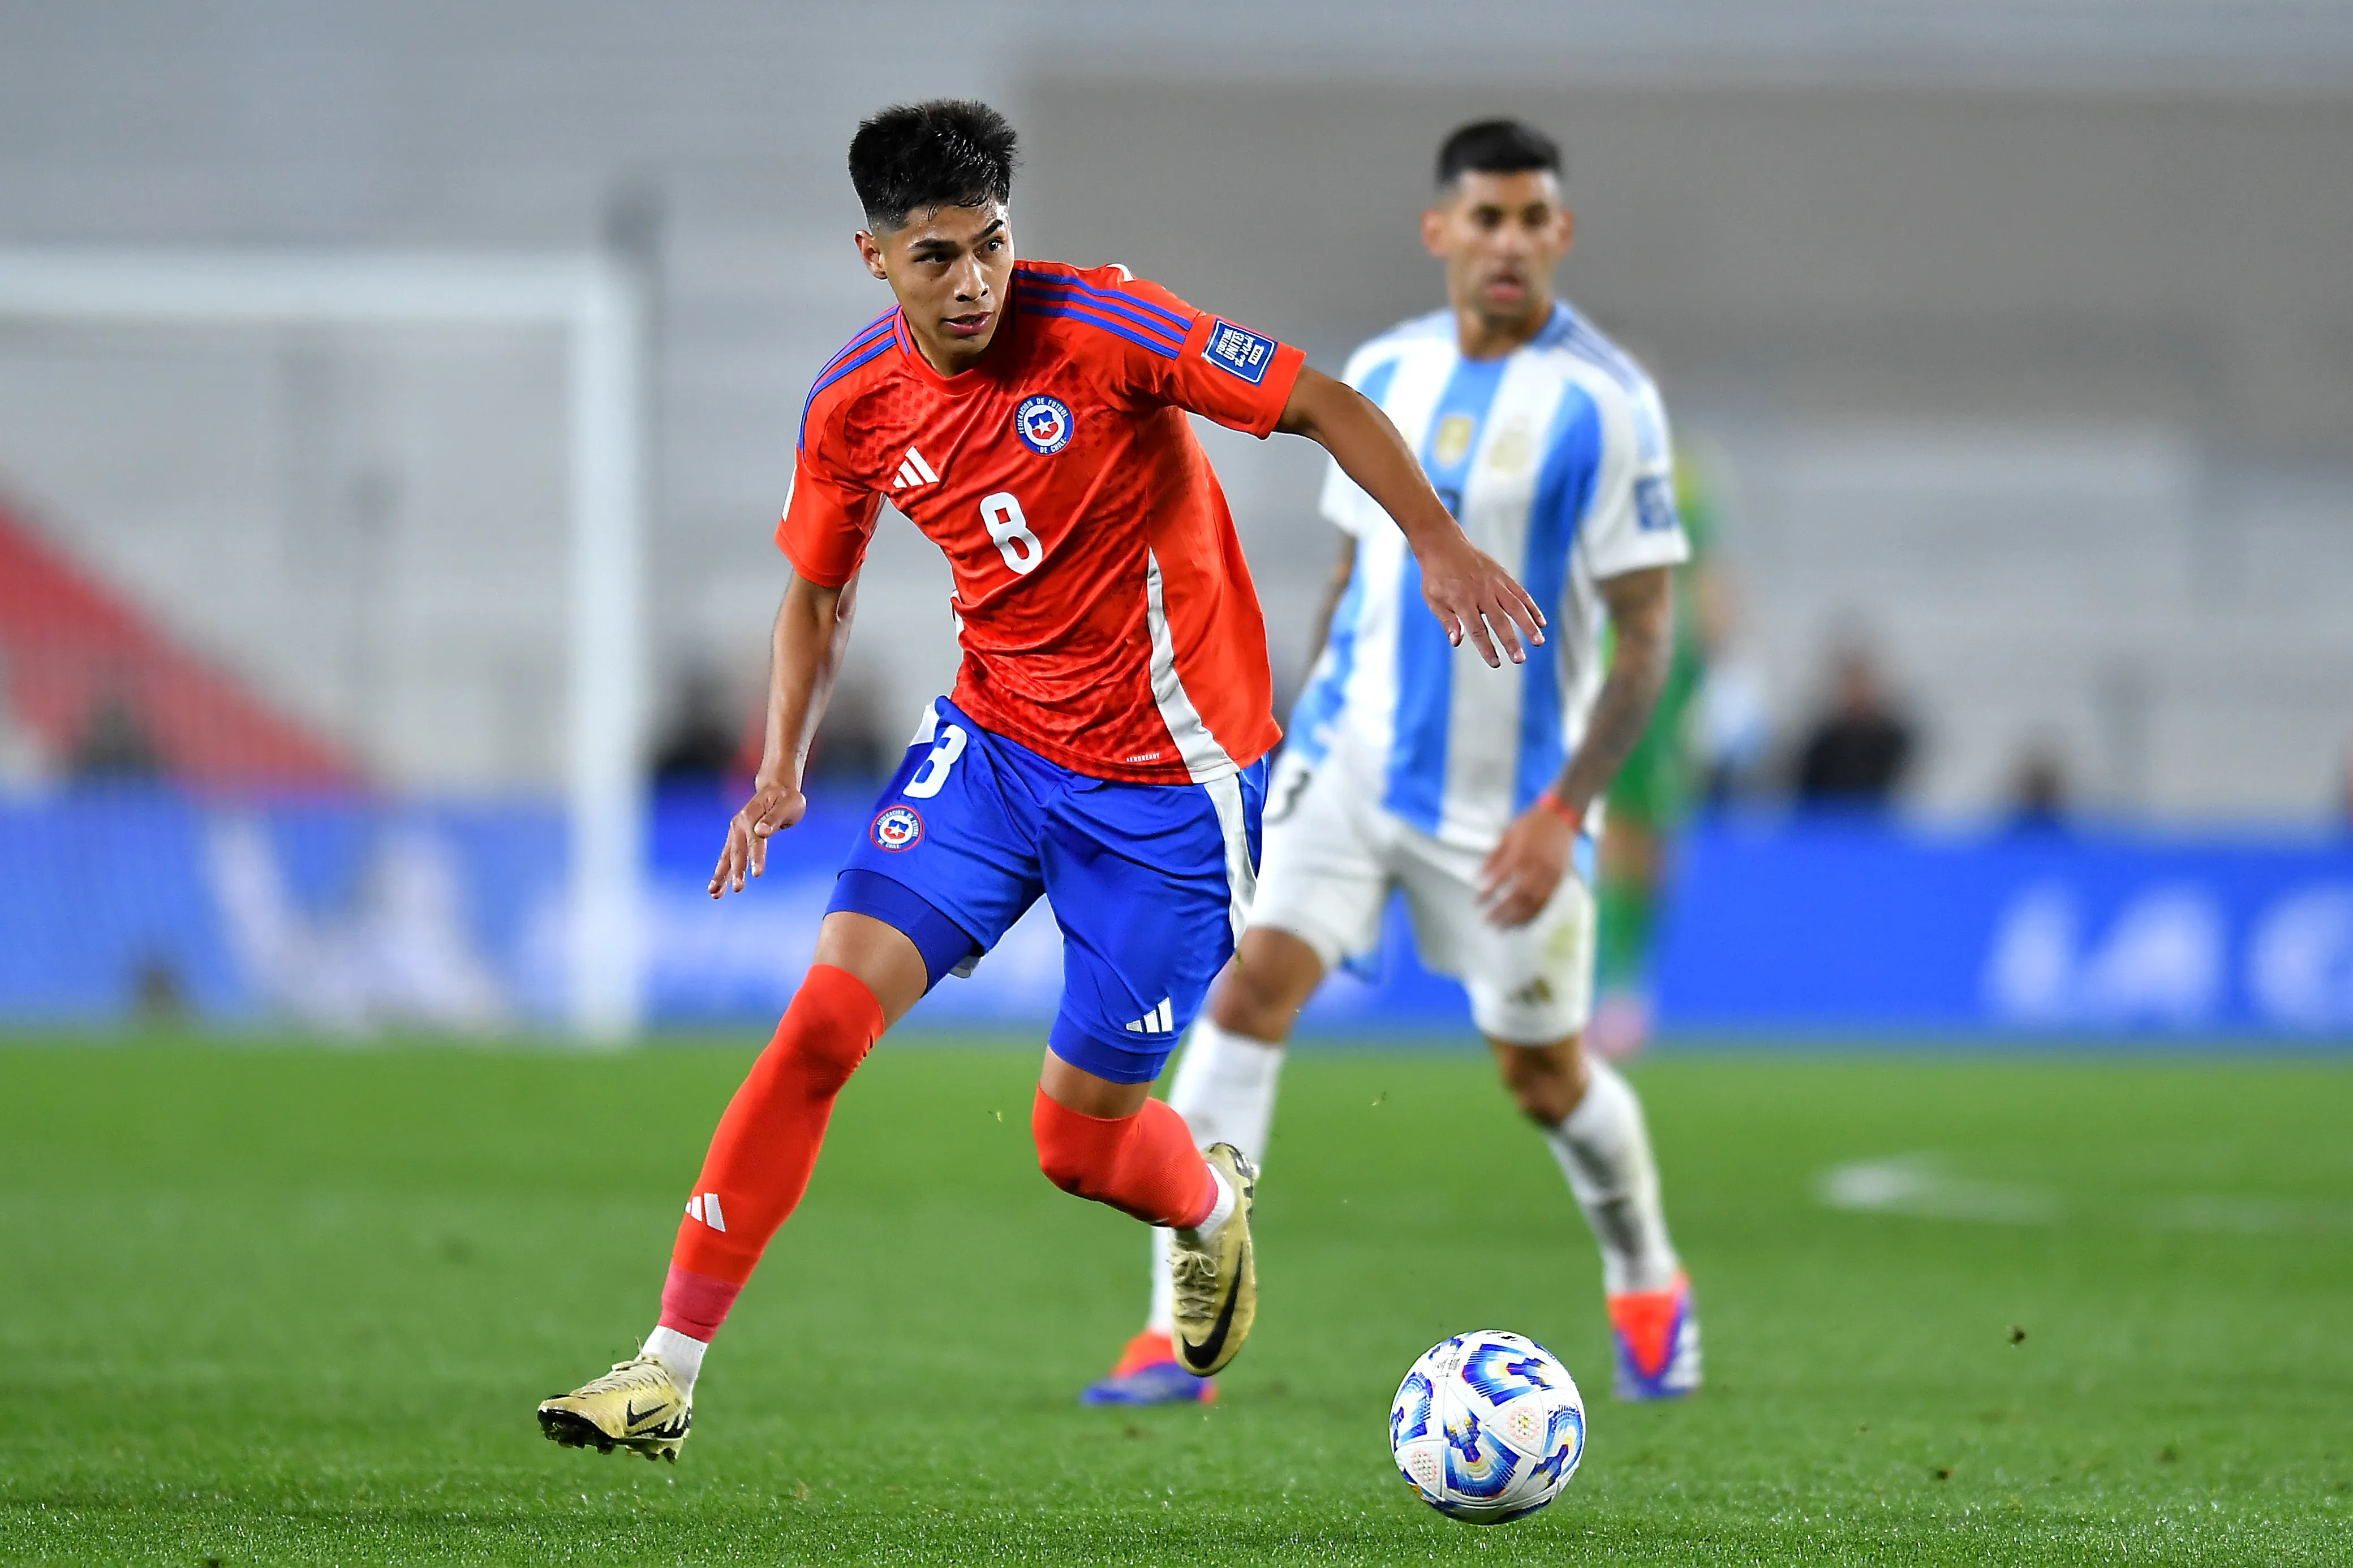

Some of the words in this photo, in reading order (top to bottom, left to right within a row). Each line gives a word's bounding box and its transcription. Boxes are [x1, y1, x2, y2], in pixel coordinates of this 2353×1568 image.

[1223, 331, 1245, 360] UNITES
[1251, 348, 1261, 361] FIFA
[1234, 354, 1246, 368] the
[1017, 400, 1033, 434] FEDERACION
[1048, 399, 1069, 419] FUTBOL
[1050, 438, 1066, 453] CHILE
[980, 492, 1043, 575] 8
